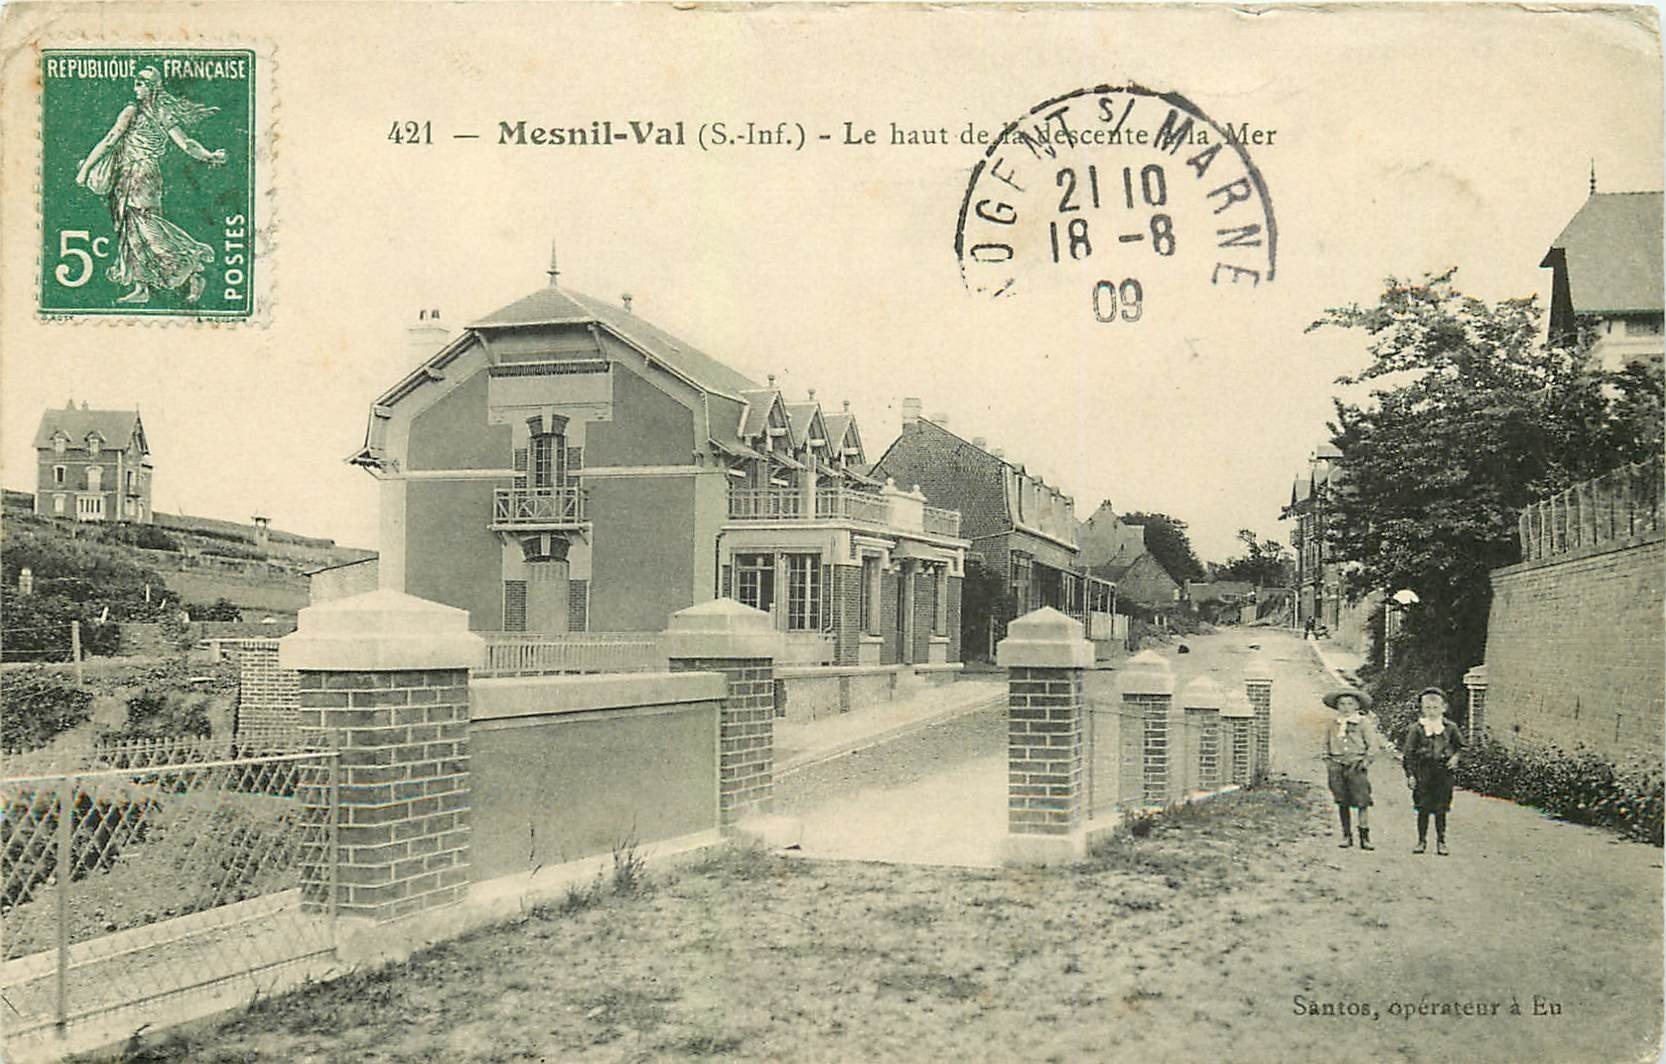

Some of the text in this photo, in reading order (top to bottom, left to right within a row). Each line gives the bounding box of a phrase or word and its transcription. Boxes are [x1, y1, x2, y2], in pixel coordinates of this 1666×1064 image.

[163, 58, 246, 81] FRANÇAISE
[1055, 163, 1168, 214] 21 10
[1152, 108, 1264, 289] MARNE
[224, 214, 245, 301] POSTES
[1049, 217, 1093, 263] 18
[1092, 277, 1144, 324] 09
